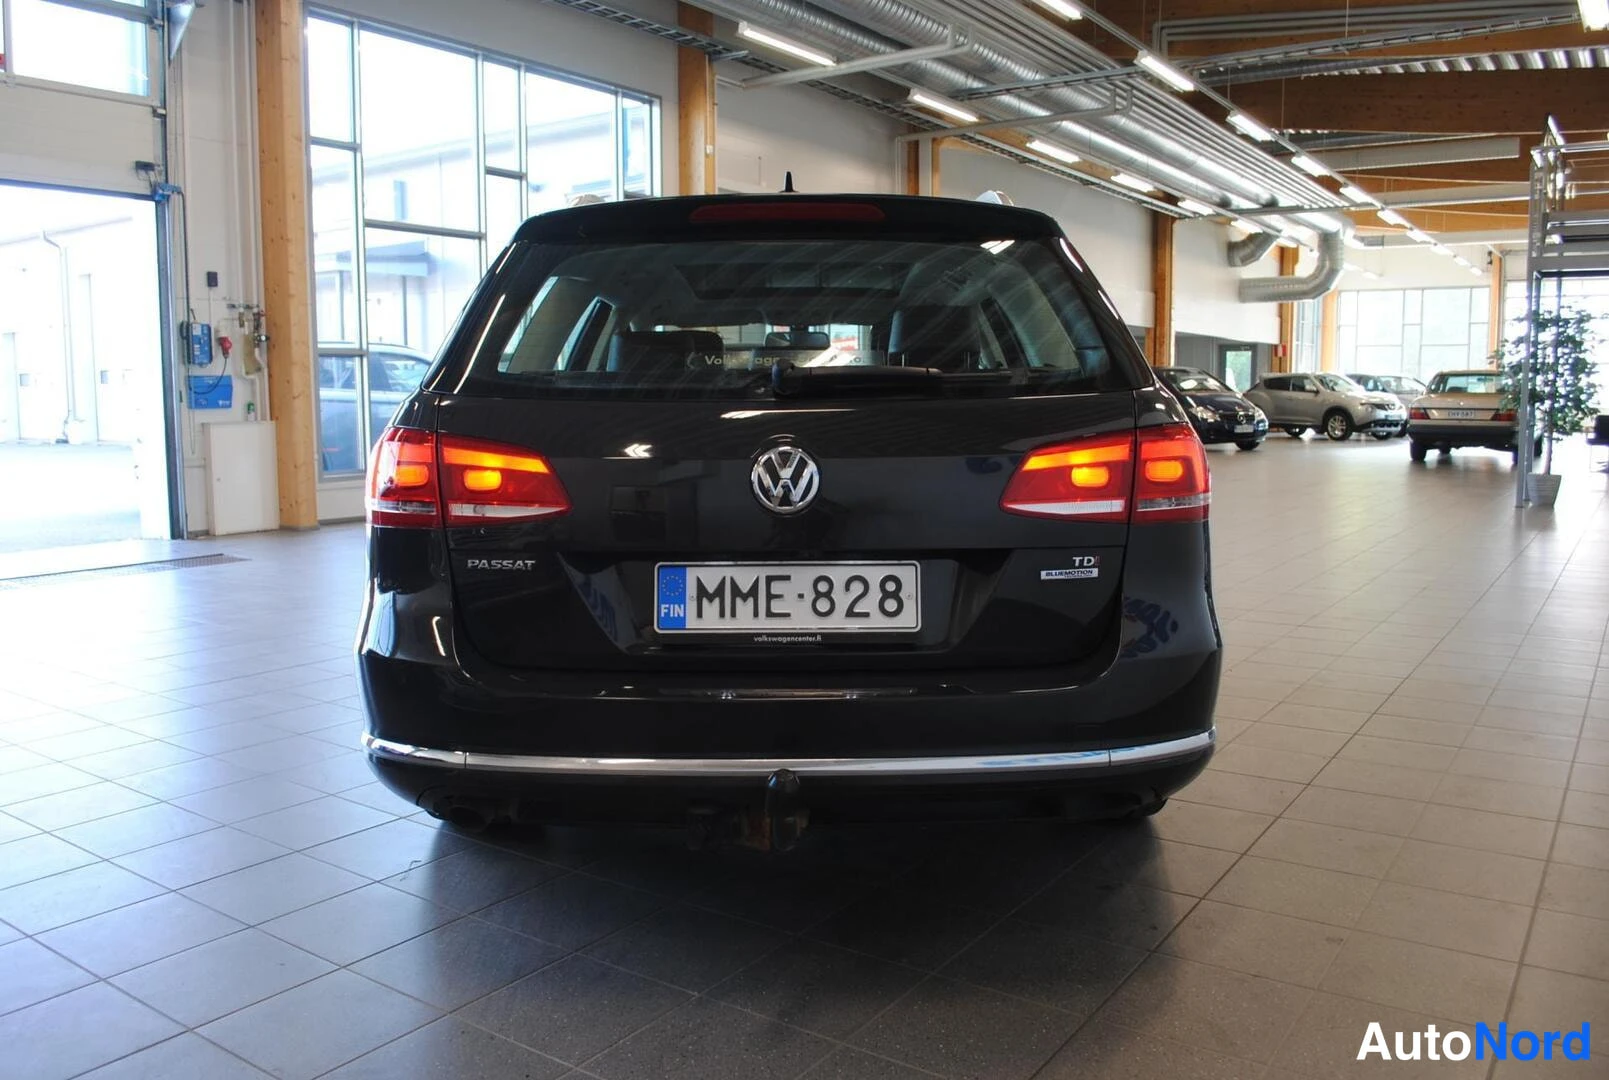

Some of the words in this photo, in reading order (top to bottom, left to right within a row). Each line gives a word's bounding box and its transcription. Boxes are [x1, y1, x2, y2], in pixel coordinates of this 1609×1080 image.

[467, 559, 536, 570] PASSAT
[1045, 569, 1093, 577] BLUEMOTION
[696, 574, 904, 619] MME-828
[661, 604, 684, 617] FIN
[753, 634, 822, 643] volkswagencenter.fi
